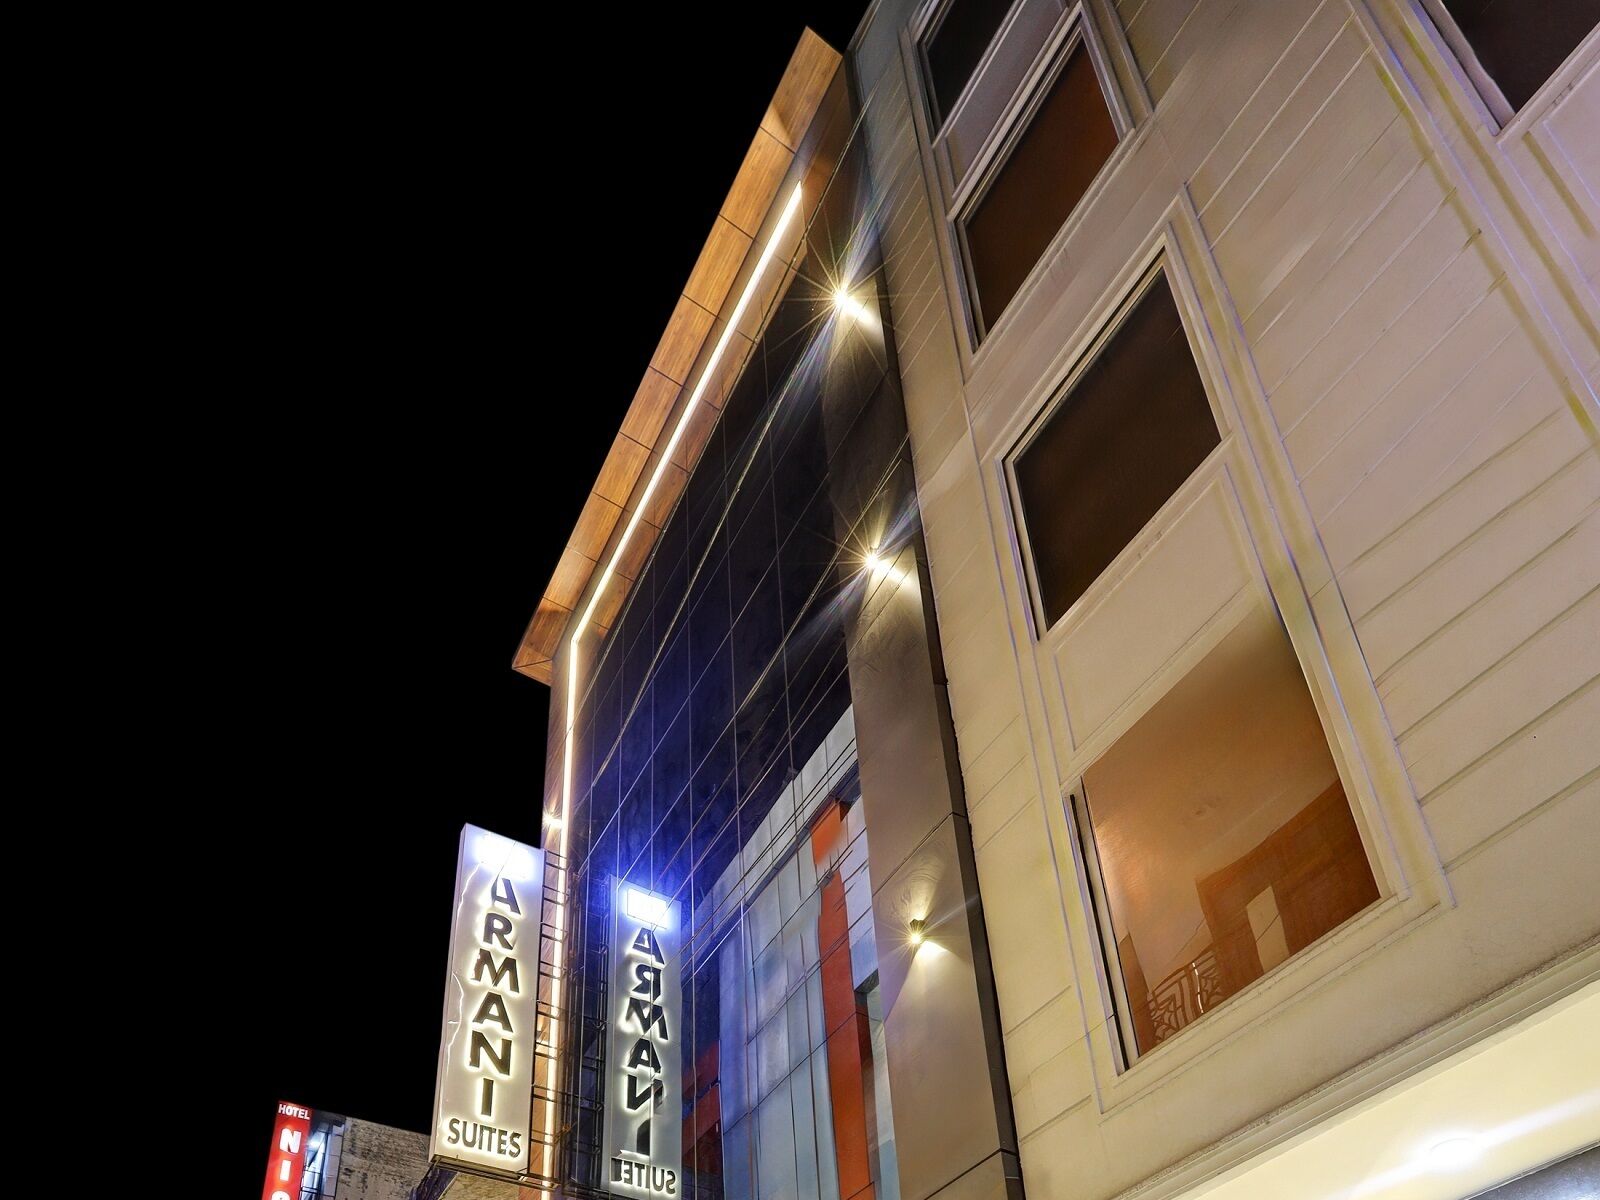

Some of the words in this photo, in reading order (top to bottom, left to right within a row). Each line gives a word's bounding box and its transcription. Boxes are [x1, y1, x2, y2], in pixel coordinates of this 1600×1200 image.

[470, 876, 522, 1117] ARMANI
[278, 1103, 311, 1120] HOTEL
[447, 1117, 522, 1158] SUITES
